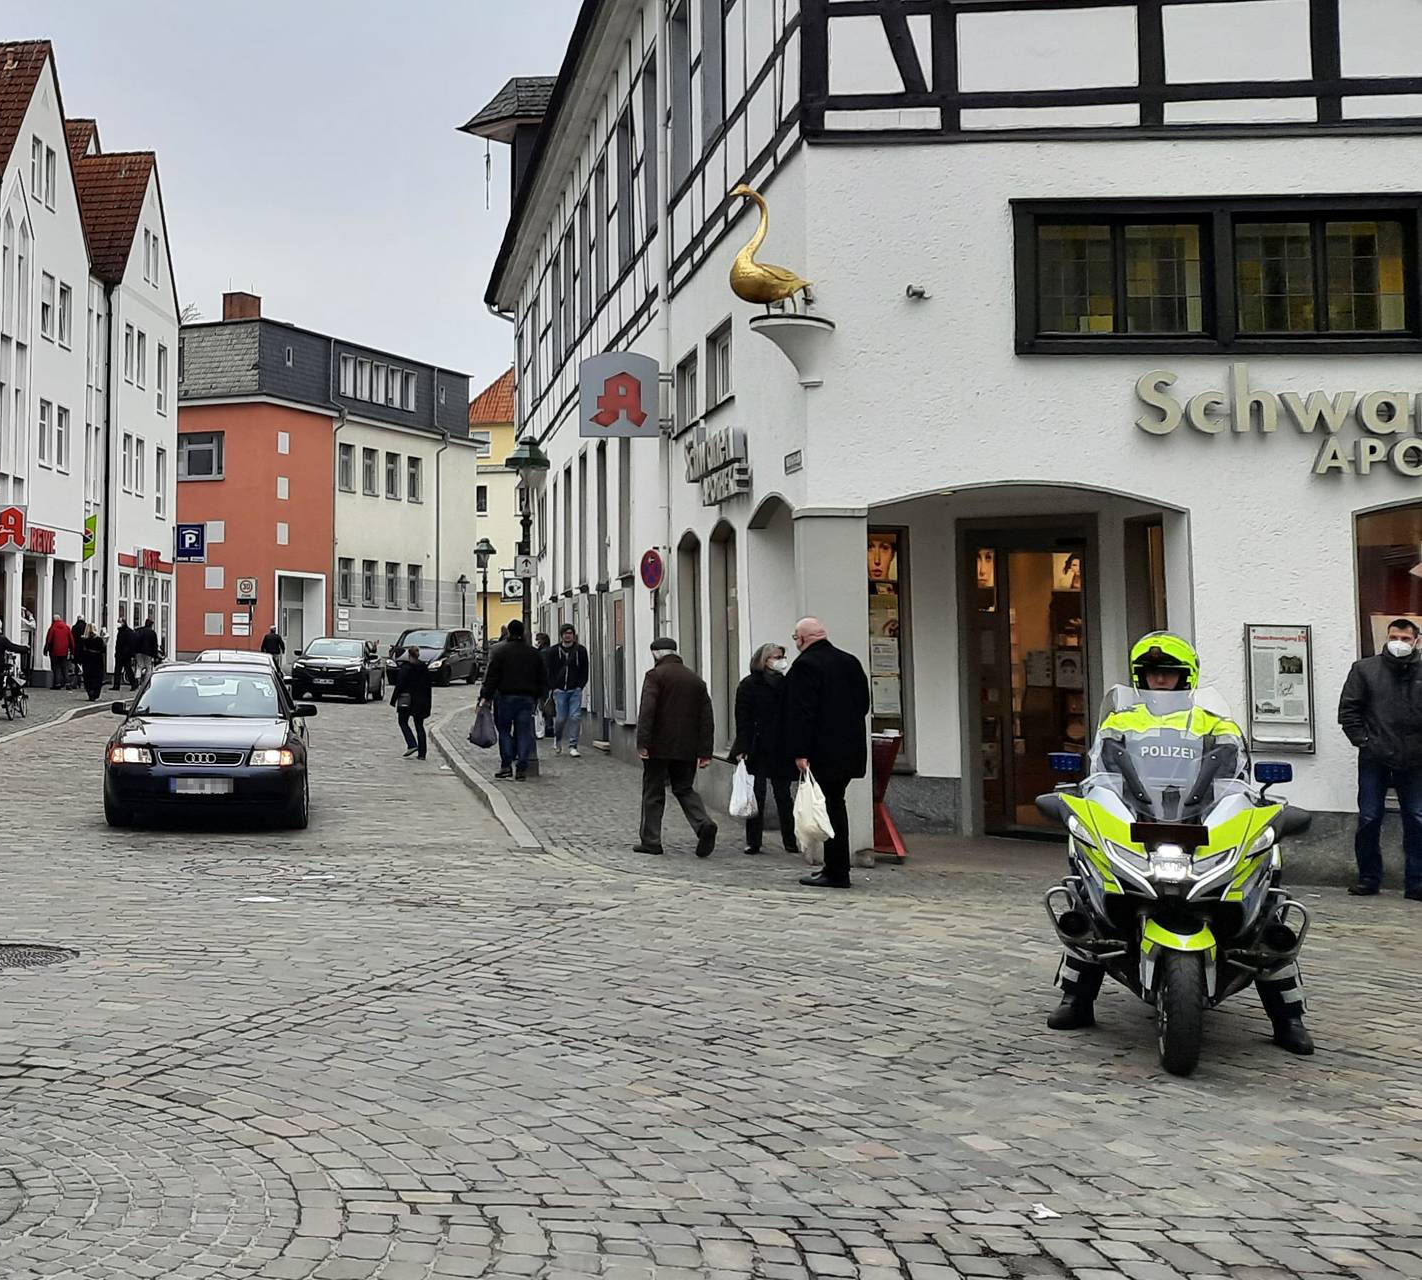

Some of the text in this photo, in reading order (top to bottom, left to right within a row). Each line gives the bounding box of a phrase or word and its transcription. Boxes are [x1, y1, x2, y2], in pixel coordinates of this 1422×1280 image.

[1134, 362, 1422, 436] Schwa
[28, 526, 57, 555] REWE
[1140, 745, 1195, 760] POLIZEI
